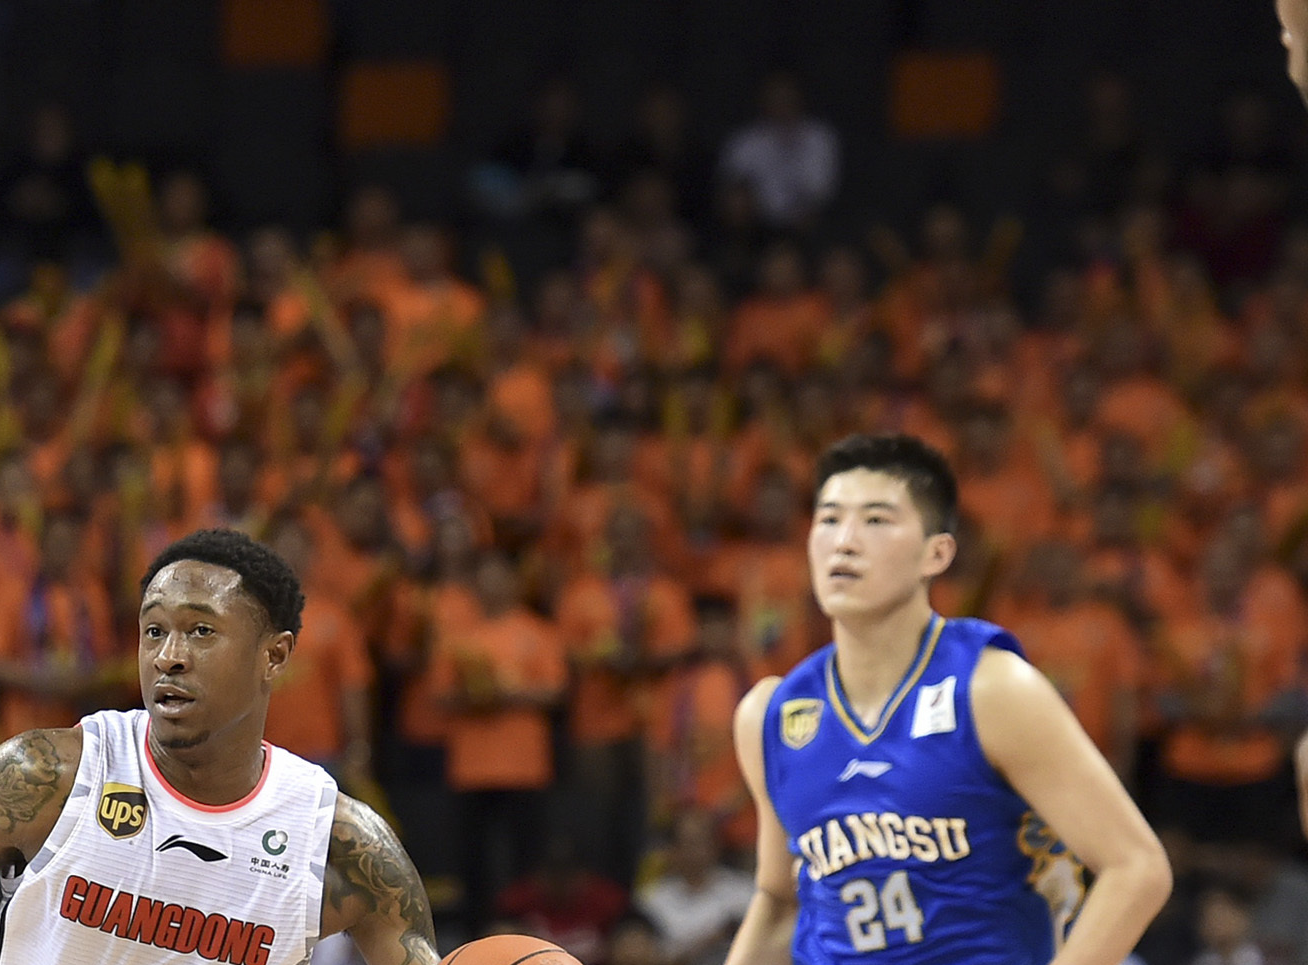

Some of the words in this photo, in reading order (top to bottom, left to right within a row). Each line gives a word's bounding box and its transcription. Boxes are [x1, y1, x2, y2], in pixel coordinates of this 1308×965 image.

[101, 796, 144, 830] ups
[250, 867, 272, 876] CHINA
[797, 812, 971, 881] JIANGSU
[840, 870, 924, 953] 24
